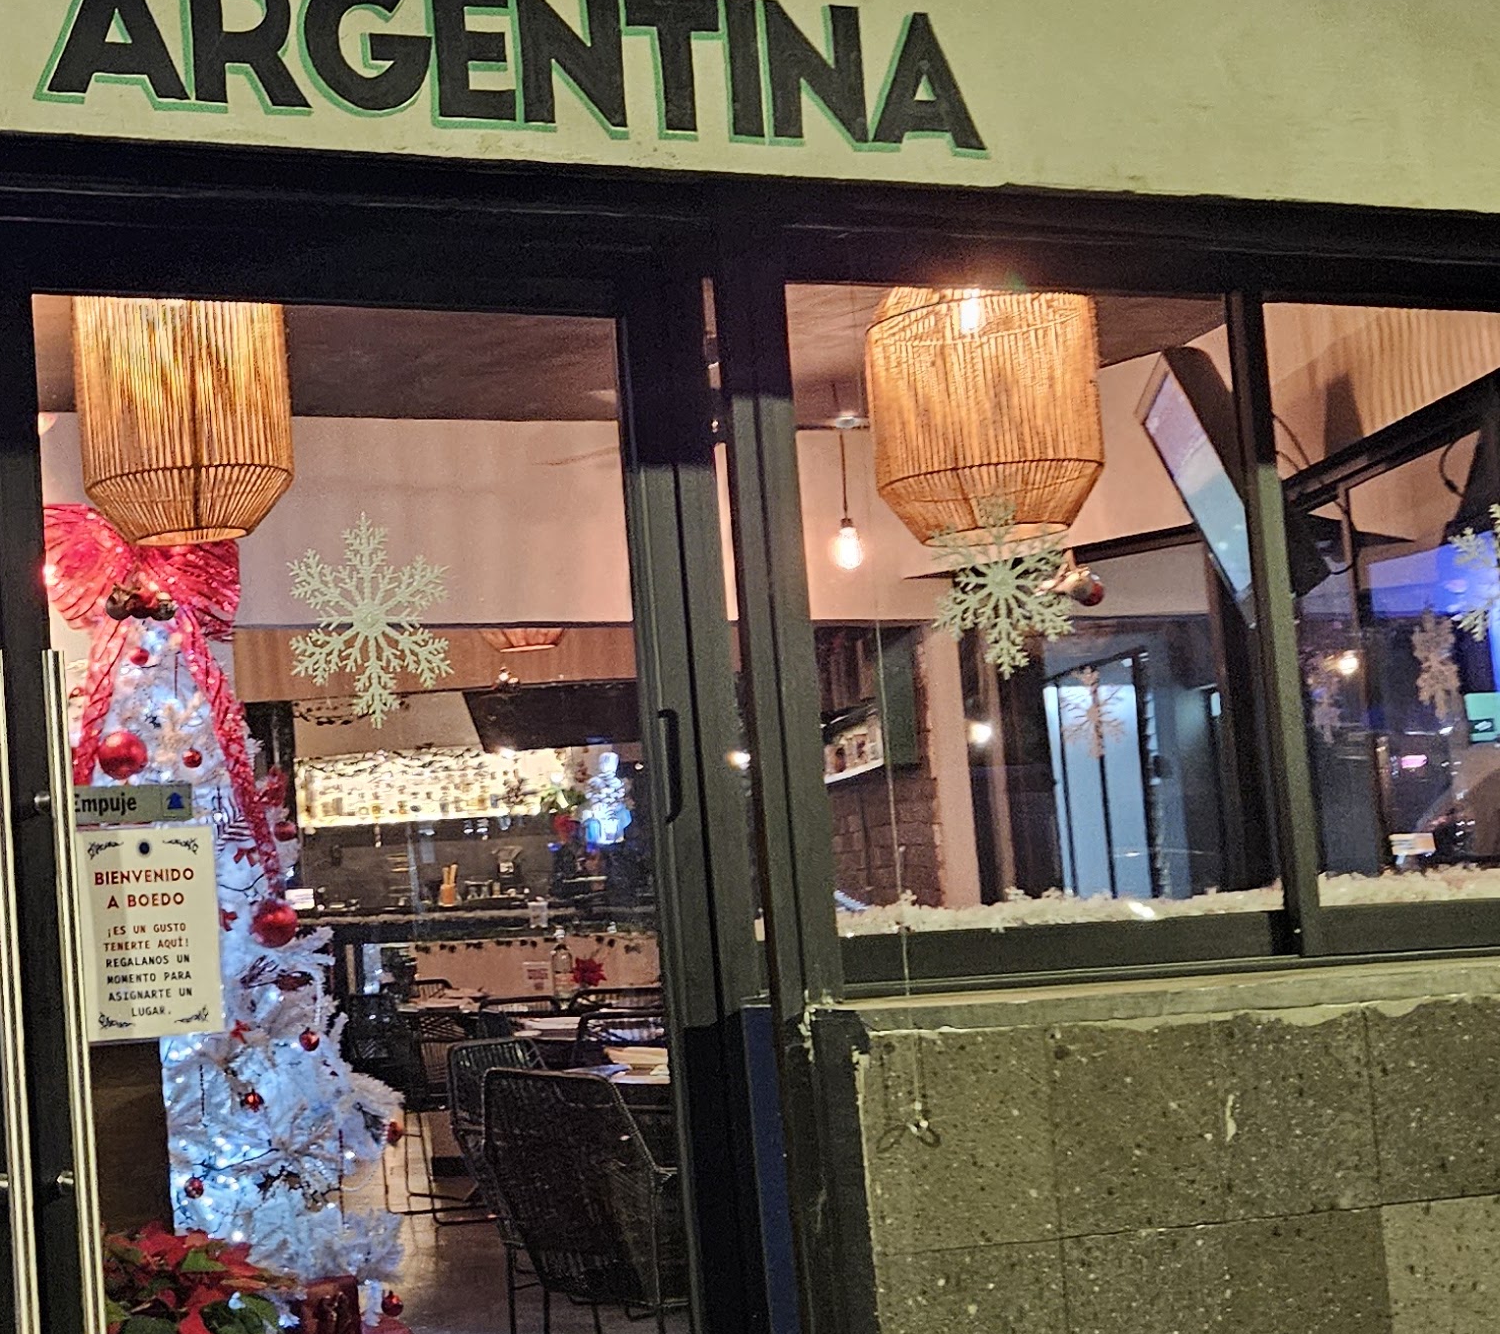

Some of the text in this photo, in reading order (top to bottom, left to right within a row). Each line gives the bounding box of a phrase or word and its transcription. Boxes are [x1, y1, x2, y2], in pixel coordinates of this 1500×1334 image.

[94, 867, 194, 886] BIENVENIDO
[107, 892, 185, 910] A BOEDO
[107, 922, 187, 938] ¡ES UN GUSTO
[104, 940, 150, 952] TENERTE
[105, 954, 190, 968] REGALANOS UN
[107, 970, 192, 984] MOMENTO PARA
[108, 987, 192, 1002] ASIGNARTE UN
[131, 1006, 171, 1017] LUGAR.
